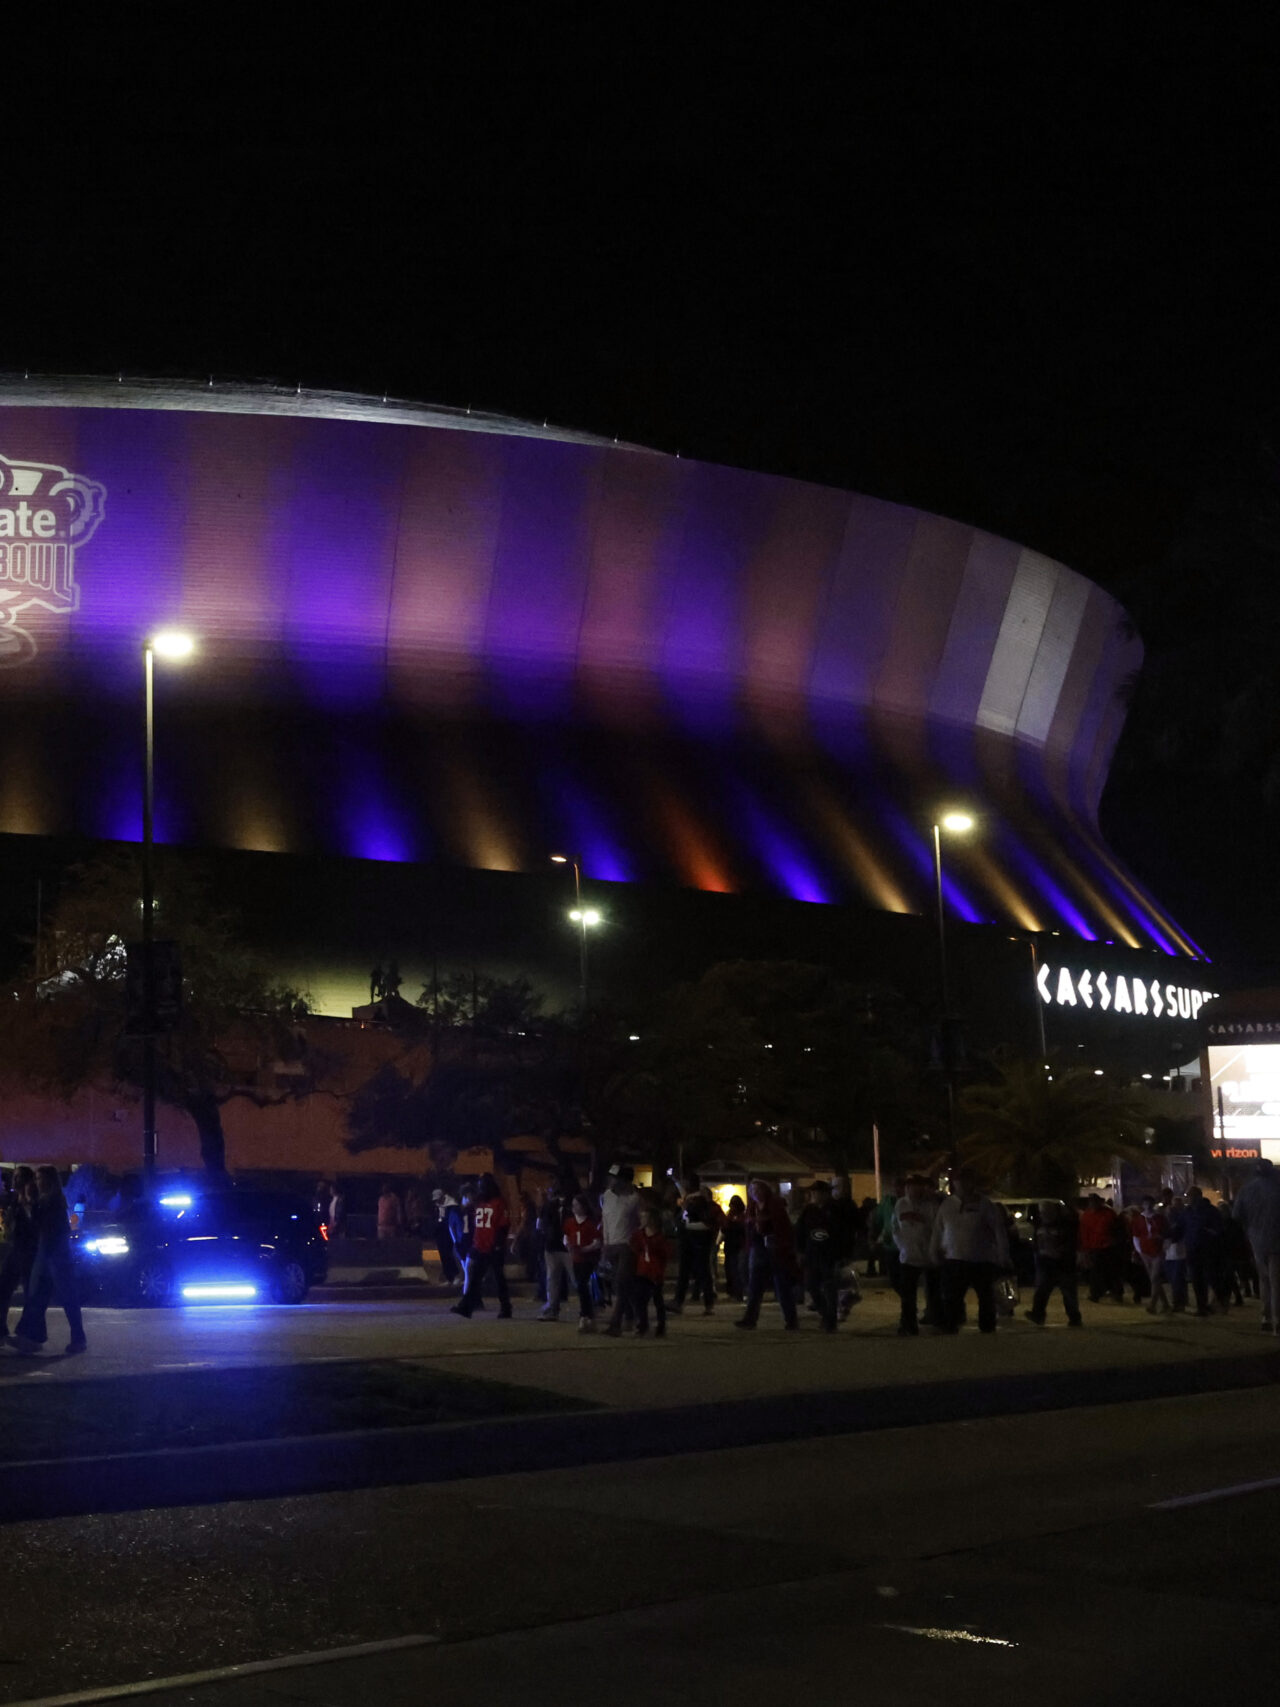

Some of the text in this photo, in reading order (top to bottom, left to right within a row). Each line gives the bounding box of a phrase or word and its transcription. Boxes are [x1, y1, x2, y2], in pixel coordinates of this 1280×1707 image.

[1036, 963, 1220, 1020] CAESARS SUP
[1209, 1023, 1273, 1034] CAESARS
[476, 1208, 493, 1228] 27
